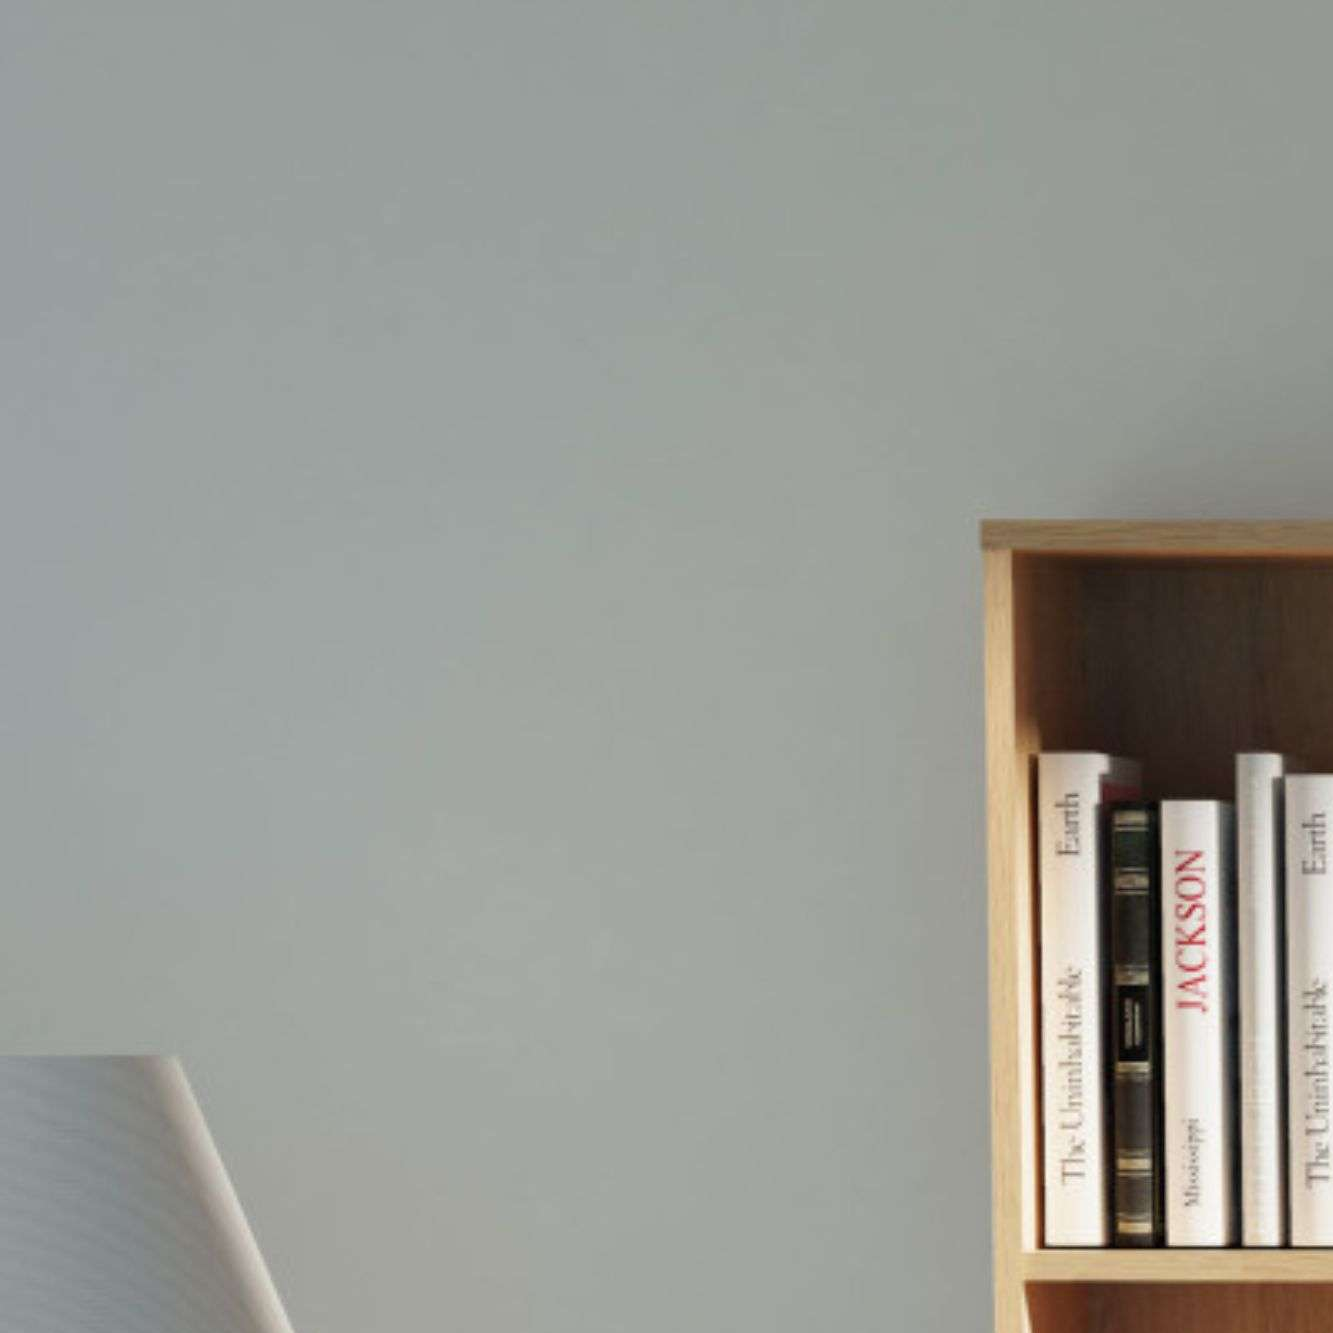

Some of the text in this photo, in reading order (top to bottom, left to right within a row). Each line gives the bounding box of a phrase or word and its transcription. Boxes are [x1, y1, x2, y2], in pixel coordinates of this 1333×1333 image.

[1055, 791, 1080, 857] Earth
[1173, 849, 1208, 1015] JACKSON
[1301, 812, 1330, 1190] The Uninhabitable Earth
[1060, 1136, 1087, 1187] The
